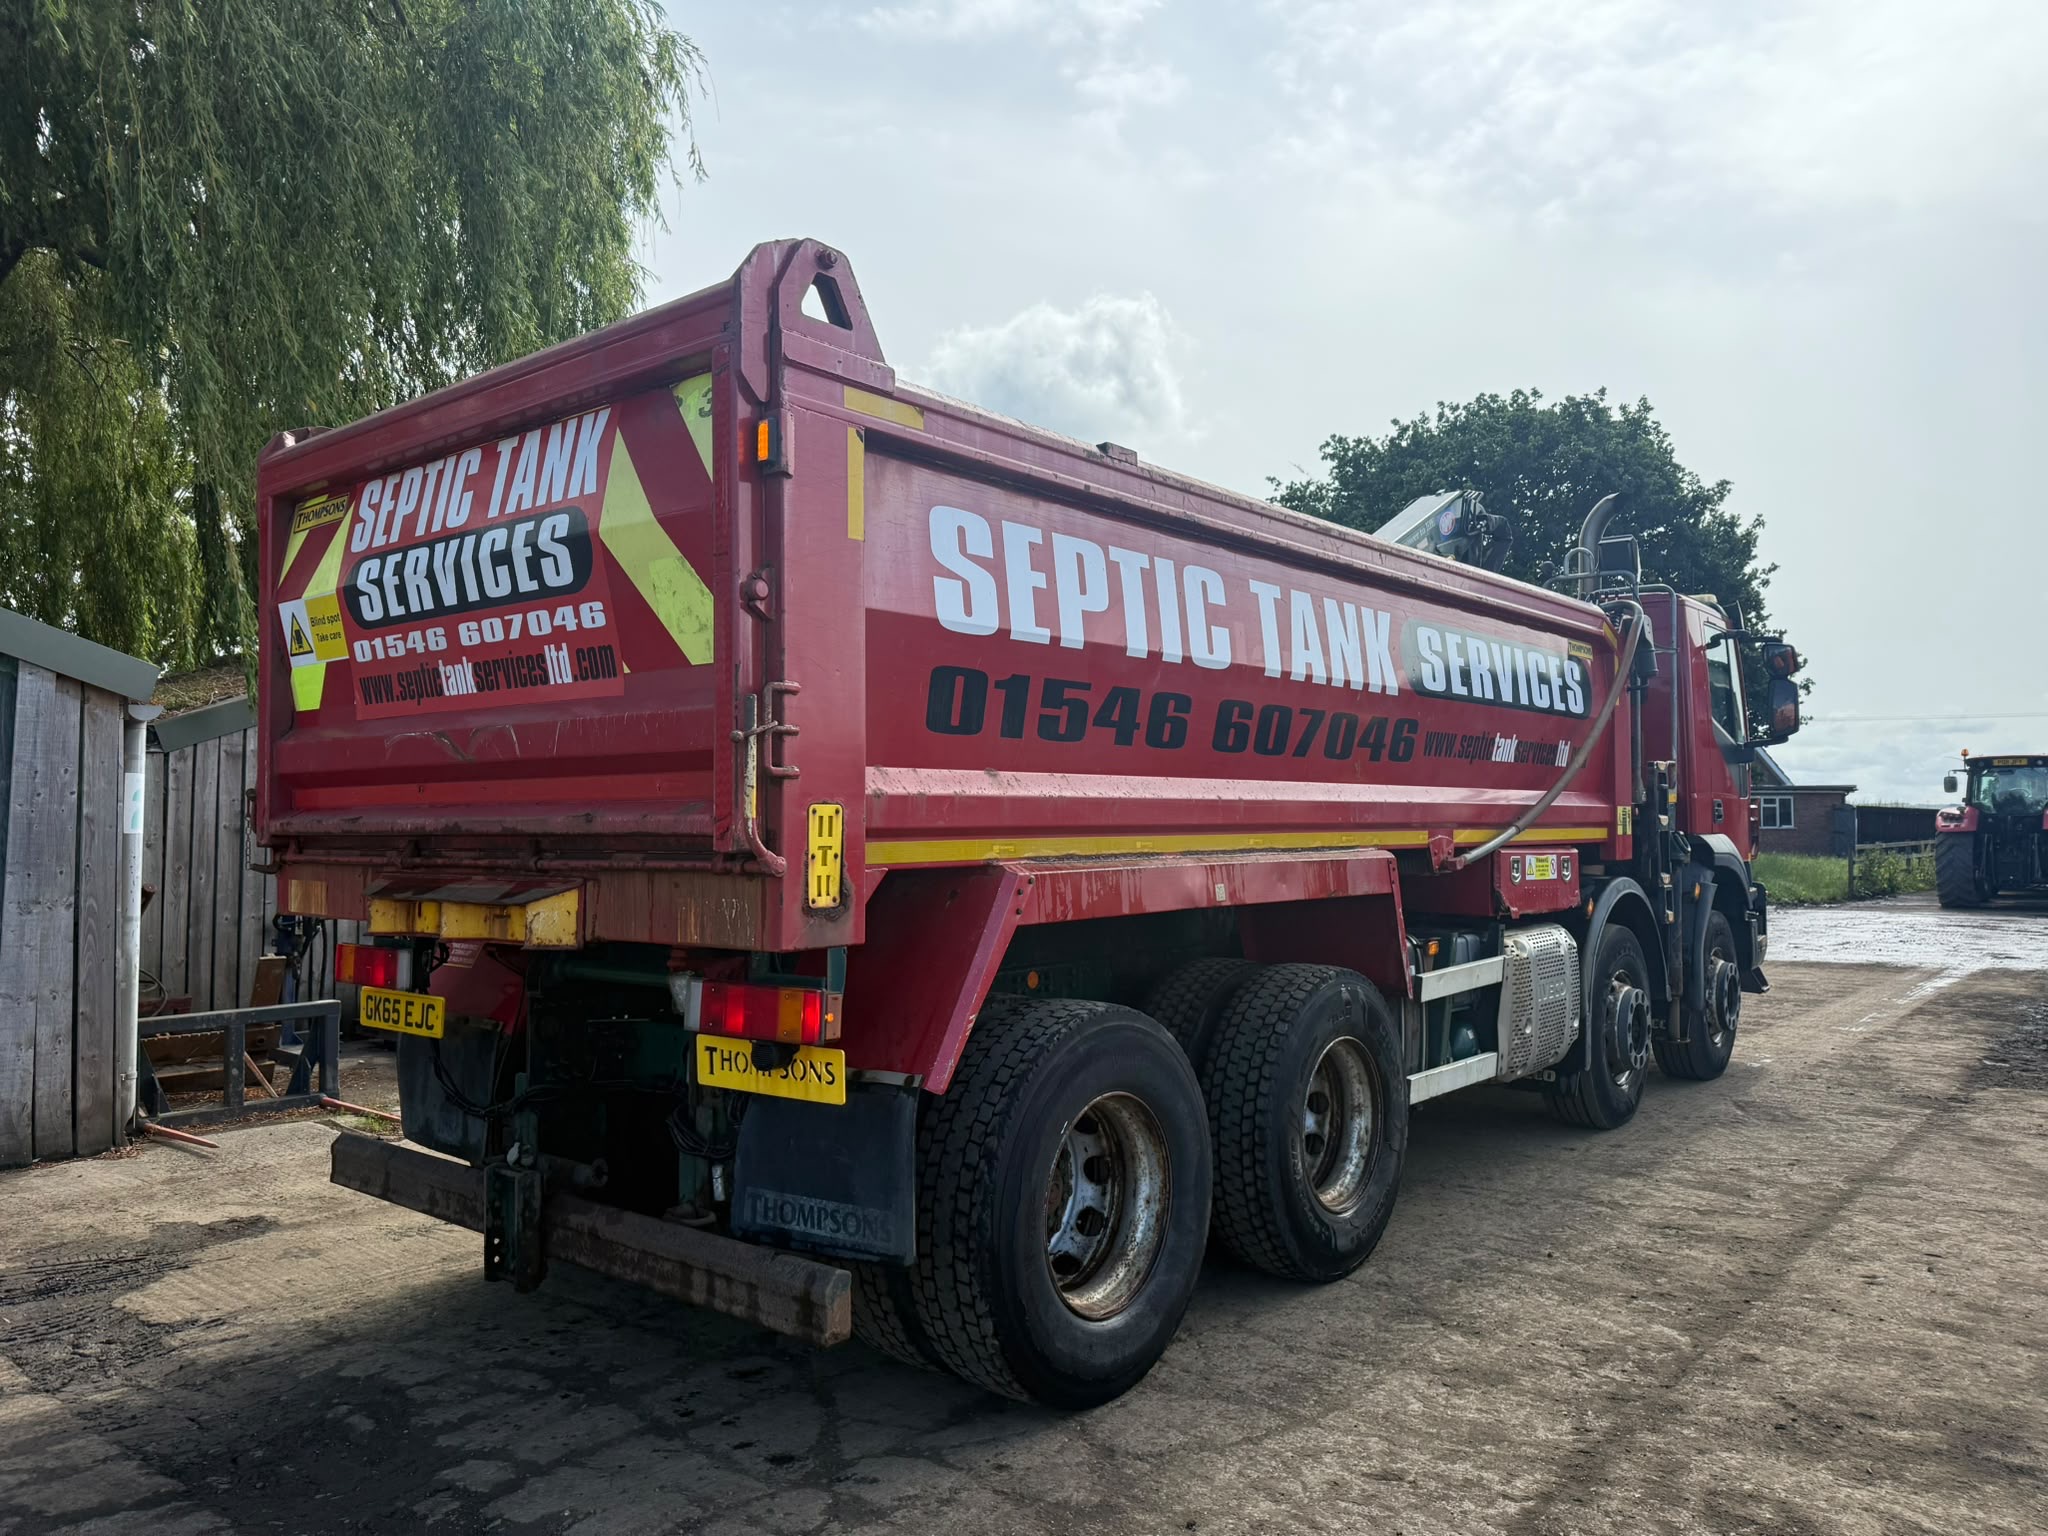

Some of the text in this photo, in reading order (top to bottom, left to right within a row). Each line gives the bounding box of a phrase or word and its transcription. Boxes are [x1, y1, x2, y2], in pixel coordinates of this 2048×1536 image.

[351, 408, 611, 553] SEPTIC TANK
[297, 499, 346, 529] THOMPSONS
[356, 513, 574, 622] SERVICES
[310, 613, 341, 627] Blind spot
[316, 632, 342, 643] Take care
[353, 601, 607, 663] 01546 607046
[929, 505, 1585, 714] SEPTIC TANK SERVICES
[359, 642, 618, 706] www.septictankservicesltd.com
[926, 665, 1192, 749] 01546
[1211, 699, 1420, 763] 607046
[366, 994, 436, 1031] GK65 EJC
[750, 1191, 893, 1244] THOMPSONS
